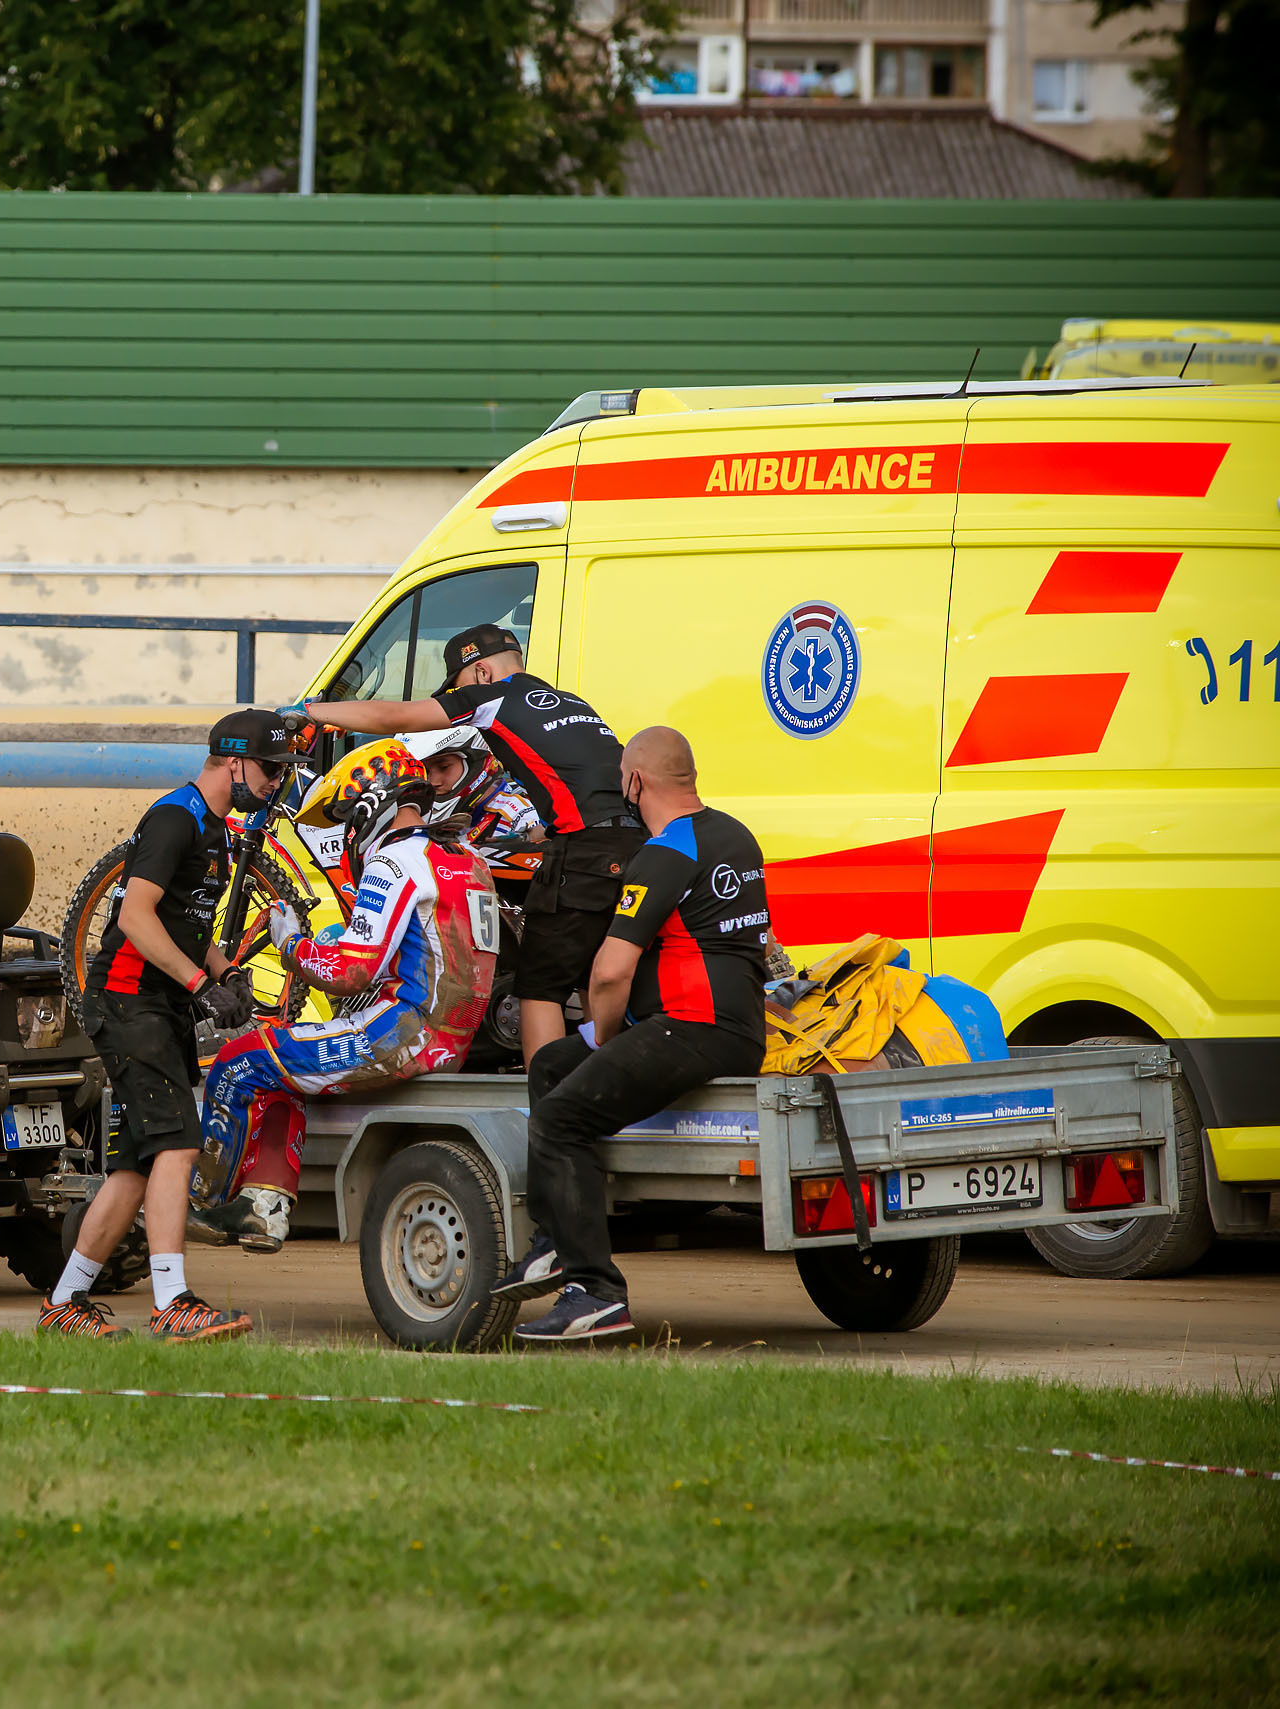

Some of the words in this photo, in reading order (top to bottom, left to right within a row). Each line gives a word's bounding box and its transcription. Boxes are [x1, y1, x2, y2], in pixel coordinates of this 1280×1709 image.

[705, 452, 936, 492] AMBULANCE
[837, 625, 854, 671] DIENESTS
[768, 625, 790, 700] NEATLIEKAMĀS
[824, 672, 853, 723] PALĪDZĪBAS
[774, 700, 824, 729] MEDICĪNISKĀS
[220, 738, 248, 750] LTE
[479, 895, 493, 948] 5
[28, 1104, 50, 1125] TF
[912, 1115, 929, 1125] Tiki
[929, 1113, 952, 1123] C-265
[994, 1106, 1045, 1118] tikitreiler.com
[6, 1133, 17, 1142] LV
[24, 1124, 61, 1144] 3300
[675, 1120, 741, 1136] tikitreiler.com
[888, 1194, 899, 1204] LV
[907, 1172, 925, 1205] P
